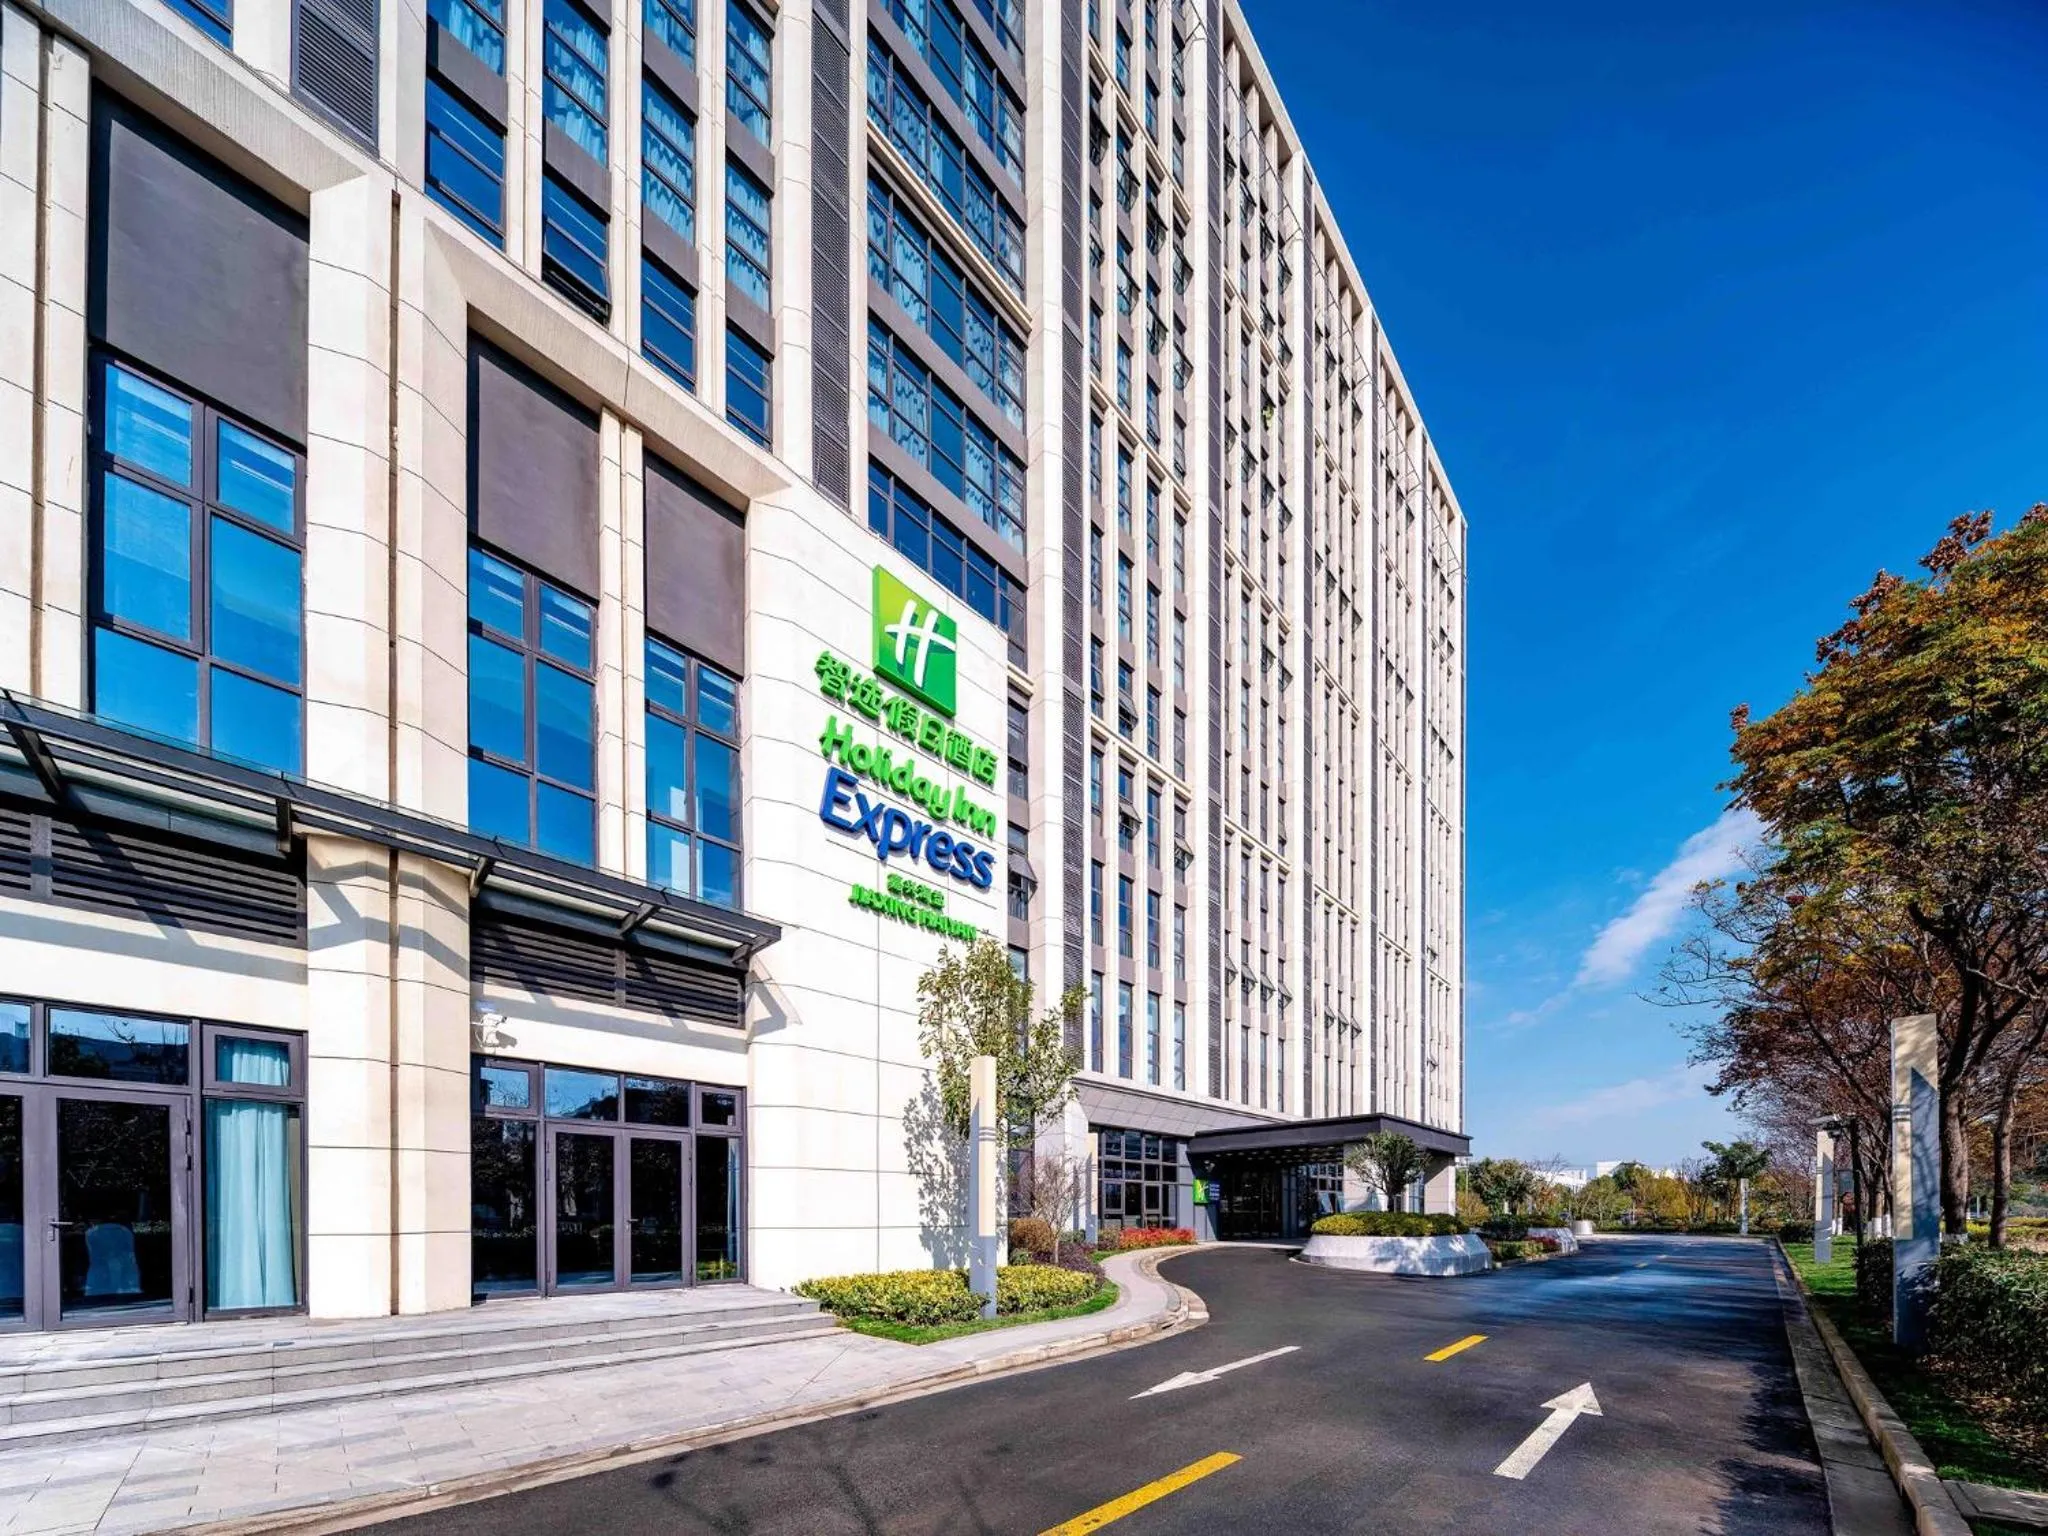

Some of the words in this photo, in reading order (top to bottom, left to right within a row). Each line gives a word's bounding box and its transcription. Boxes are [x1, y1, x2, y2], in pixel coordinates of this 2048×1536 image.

[814, 651, 998, 786] 智选假日酒店
[819, 715, 951, 821] Holiday
[952, 785, 997, 838] Inn
[819, 766, 995, 888] Express
